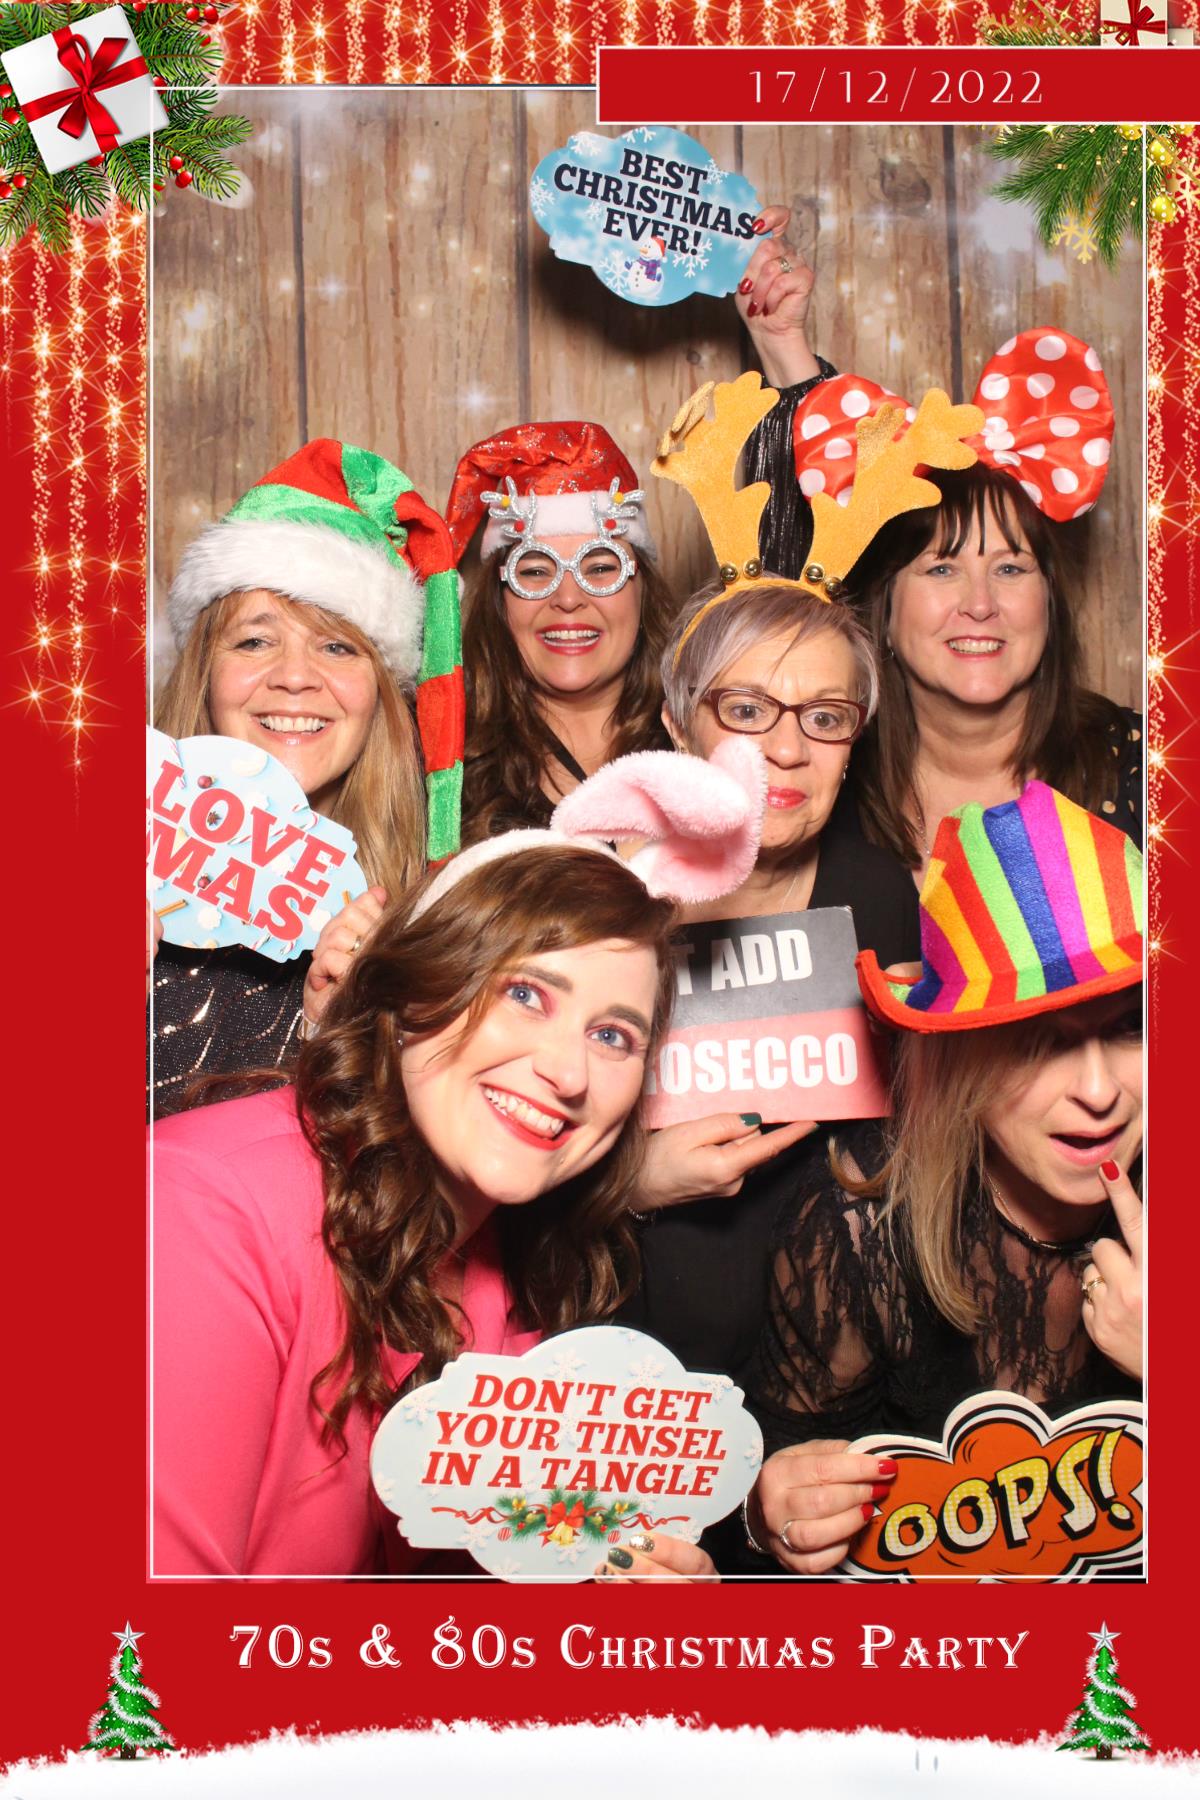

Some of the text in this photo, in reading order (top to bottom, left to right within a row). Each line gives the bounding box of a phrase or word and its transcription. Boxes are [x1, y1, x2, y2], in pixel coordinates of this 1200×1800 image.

[553, 162, 757, 240] CHRISTMAS
[619, 147, 709, 196] BEST
[602, 207, 703, 257] EVER!
[146, 759, 347, 898] LOVE
[145, 817, 318, 942] MAS
[710, 928, 814, 992] ADD
[644, 1032, 859, 1096] OSECCO
[467, 1373, 713, 1423] DON'T GET
[435, 1410, 728, 1461] YOUR TINSEL
[421, 1450, 720, 1497] IN A TANGLE
[878, 1423, 1135, 1562] OOPS!
